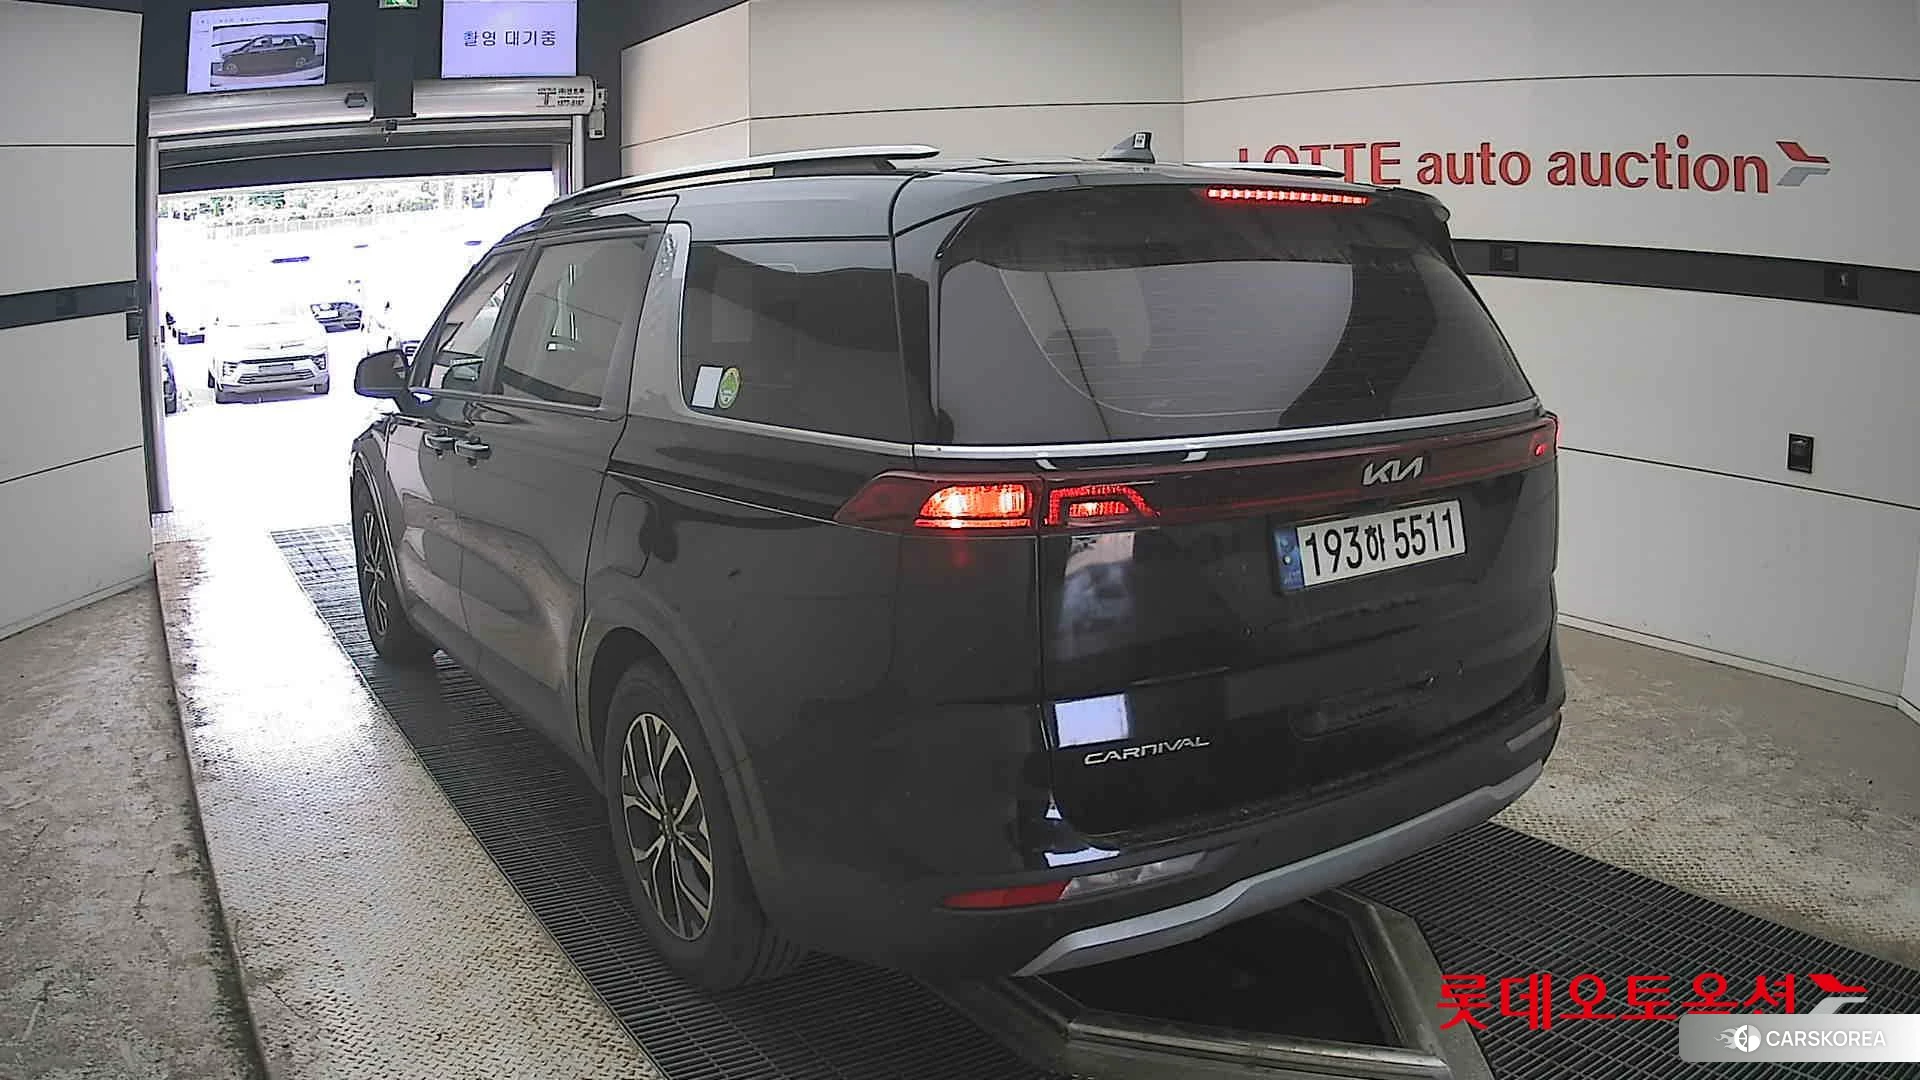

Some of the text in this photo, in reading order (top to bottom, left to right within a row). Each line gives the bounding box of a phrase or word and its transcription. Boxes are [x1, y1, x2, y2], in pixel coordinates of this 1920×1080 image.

[463, 30, 557, 47] 촬영 대기중
[1416, 142, 1532, 186] auto
[1547, 134, 1769, 193] auction
[1362, 456, 1424, 486] KIA
[1305, 507, 1456, 577] 193하 5511
[1083, 736, 1211, 766] CARNIVAL
